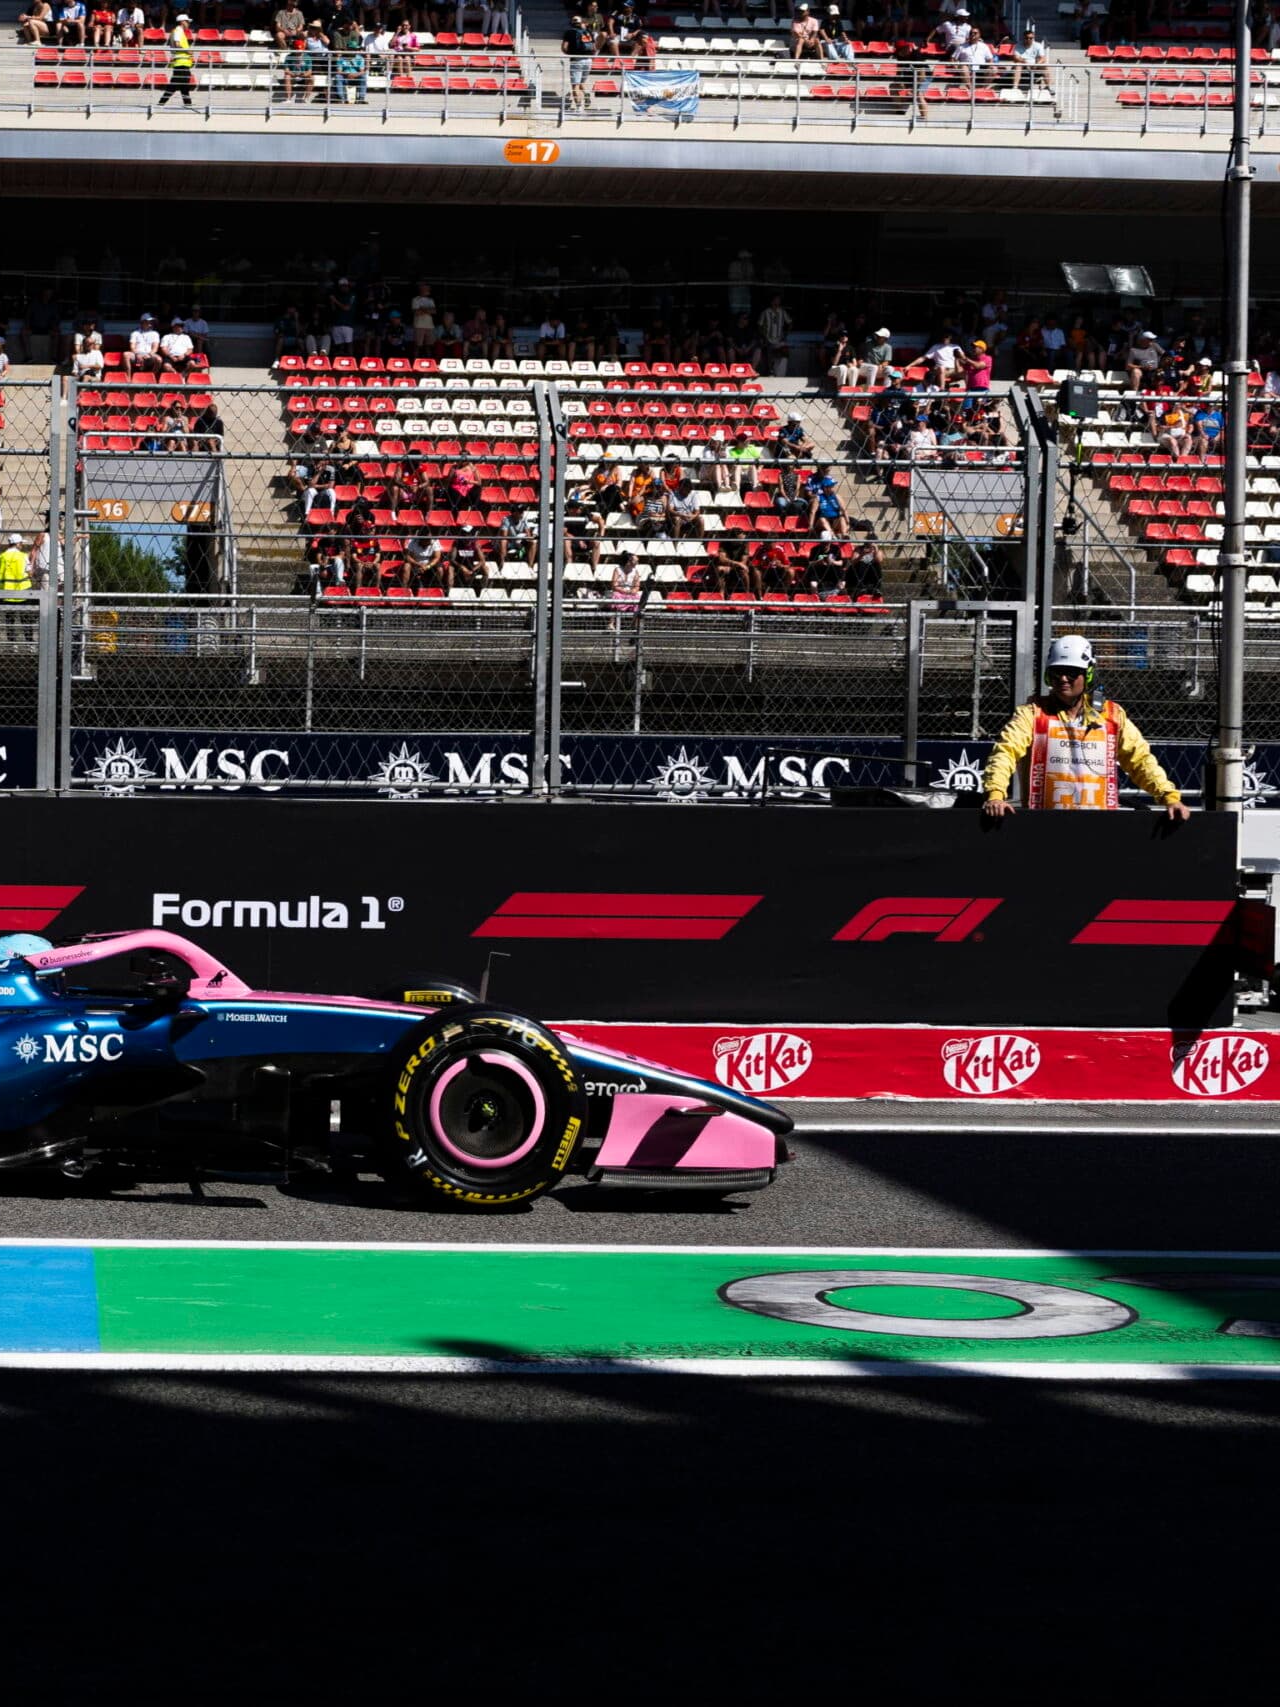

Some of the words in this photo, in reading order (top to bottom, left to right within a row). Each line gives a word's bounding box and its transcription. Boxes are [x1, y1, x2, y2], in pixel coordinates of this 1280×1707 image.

[526, 142, 555, 161] 17
[102, 502, 123, 517] 16
[160, 748, 289, 791] MSC
[722, 755, 850, 799] MSC
[1050, 756, 1070, 765] GRID
[1072, 757, 1105, 766] MARSHAL
[1107, 735, 1116, 807] BARCELONA
[152, 893, 349, 928] Formula
[831, 897, 1005, 942] F1
[43, 1033, 125, 1063] MSC
[726, 1034, 808, 1091] KitKat
[955, 1036, 1037, 1092] KitKat
[1183, 1036, 1264, 1094] KitKat
[394, 1036, 437, 1116] ZERO
[551, 1116, 581, 1171] PIRELLI
